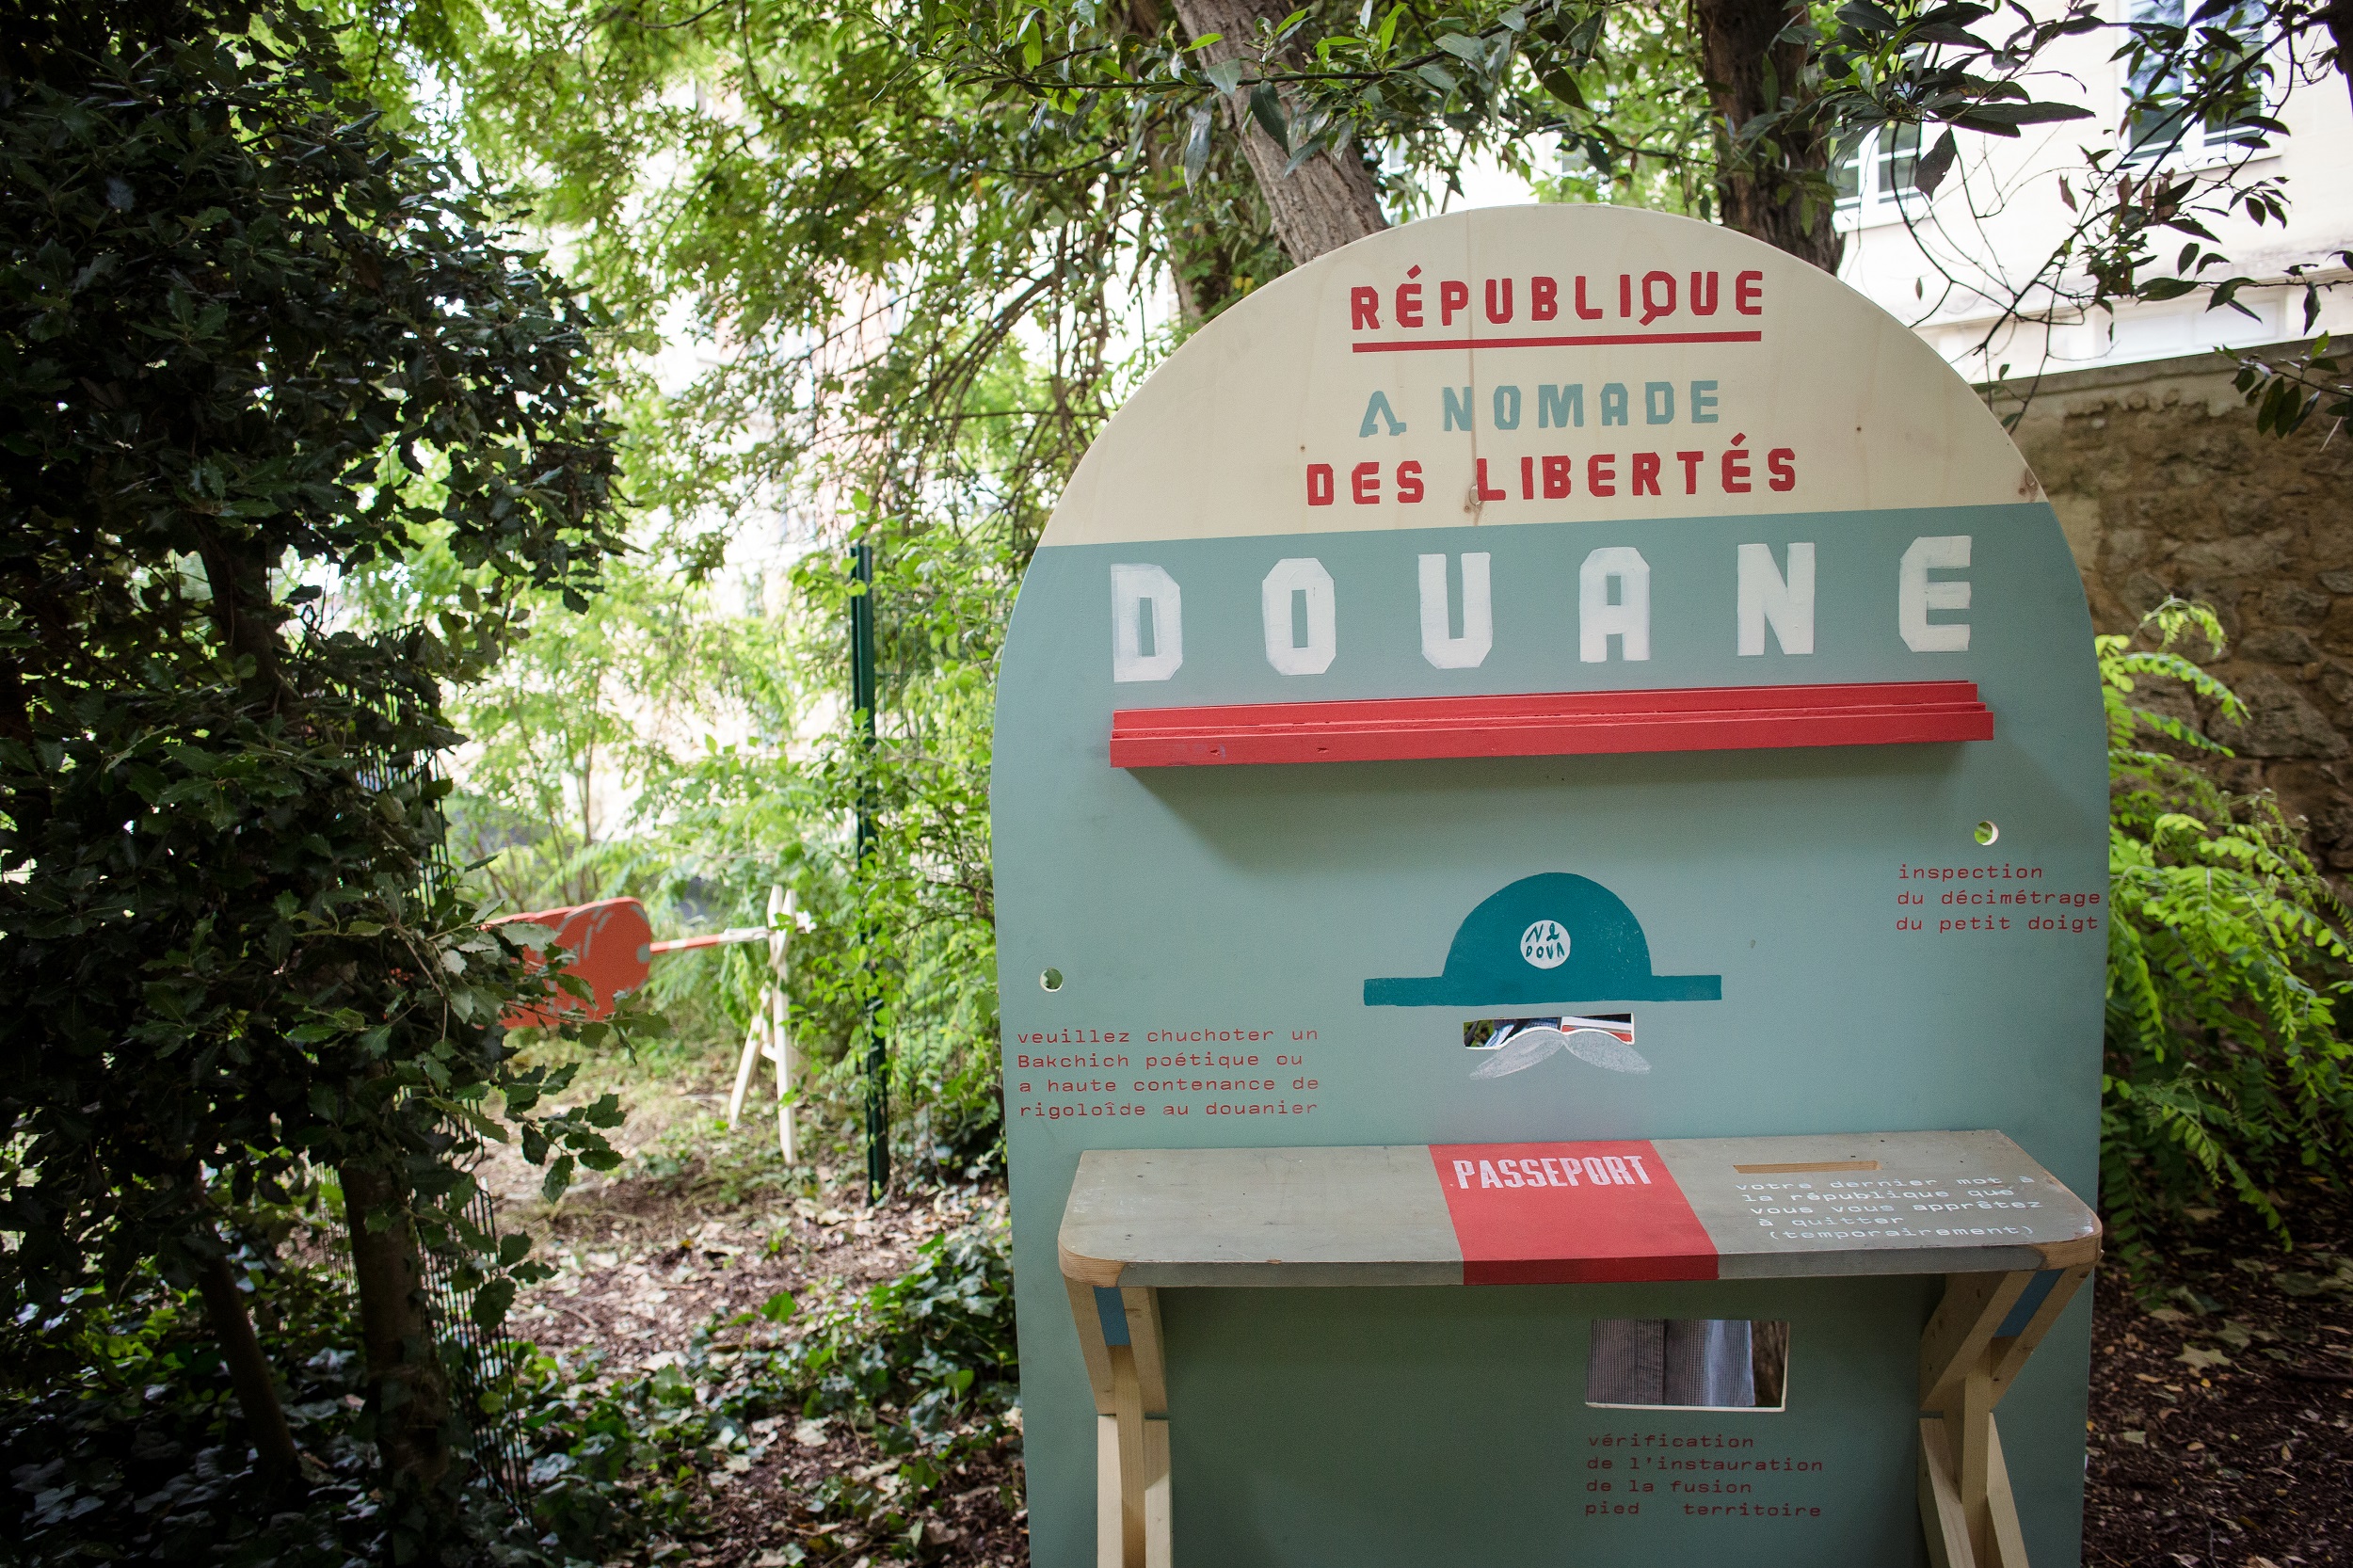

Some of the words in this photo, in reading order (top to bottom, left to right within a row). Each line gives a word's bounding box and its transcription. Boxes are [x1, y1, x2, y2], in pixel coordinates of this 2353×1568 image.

[1350, 264, 1763, 330] RÉPUBLIQUE
[1442, 380, 1719, 432] NOMADE
[1306, 460, 1424, 505] DES
[1477, 433, 1796, 502] LIBERTÉS
[1111, 536, 1972, 681] DOUANE
[1898, 863, 2042, 882] inspection
[1897, 891, 1924, 904] du
[1942, 889, 2101, 907] décimétrage
[1896, 917, 1922, 931] du
[1940, 915, 2010, 933] petit
[2028, 915, 2098, 933] doigt
[1017, 1030, 1130, 1044] veuillez
[1147, 1028, 1274, 1043] chuchoter
[1292, 1030, 1319, 1041] un
[1018, 1053, 1129, 1068] Bakchich
[1145, 1052, 1259, 1069] poétique
[1276, 1054, 1303, 1065] ou
[1048, 1080, 1117, 1093] haute
[1133, 1079, 1275, 1093] contenance
[1292, 1077, 1319, 1090] de
[1163, 1103, 1189, 1115] au
[1206, 1099, 1318, 1115] douanier
[1453, 1156, 1652, 1189] PASSEPORT
[1736, 1182, 1812, 1192] votre
[1830, 1178, 1937, 1189] dernier
[1790, 1190, 1949, 1203] république
[1967, 1188, 2014, 1199] que
[1750, 1206, 1813, 1214] vous
[1832, 1204, 1896, 1213] vous
[1913, 1200, 2043, 1213] apprêtez
[1792, 1216, 1904, 1227] quitter
[1770, 1225, 2034, 1240] (temporairement)
[1589, 1432, 1753, 1448] vérification
[1587, 1457, 1613, 1470] de
[1586, 1480, 1611, 1492] de
[1629, 1480, 1654, 1492] la
[1671, 1480, 1753, 1493] fusion
[1585, 1501, 1640, 1516] pied
[1684, 1503, 1821, 1517] territoire
